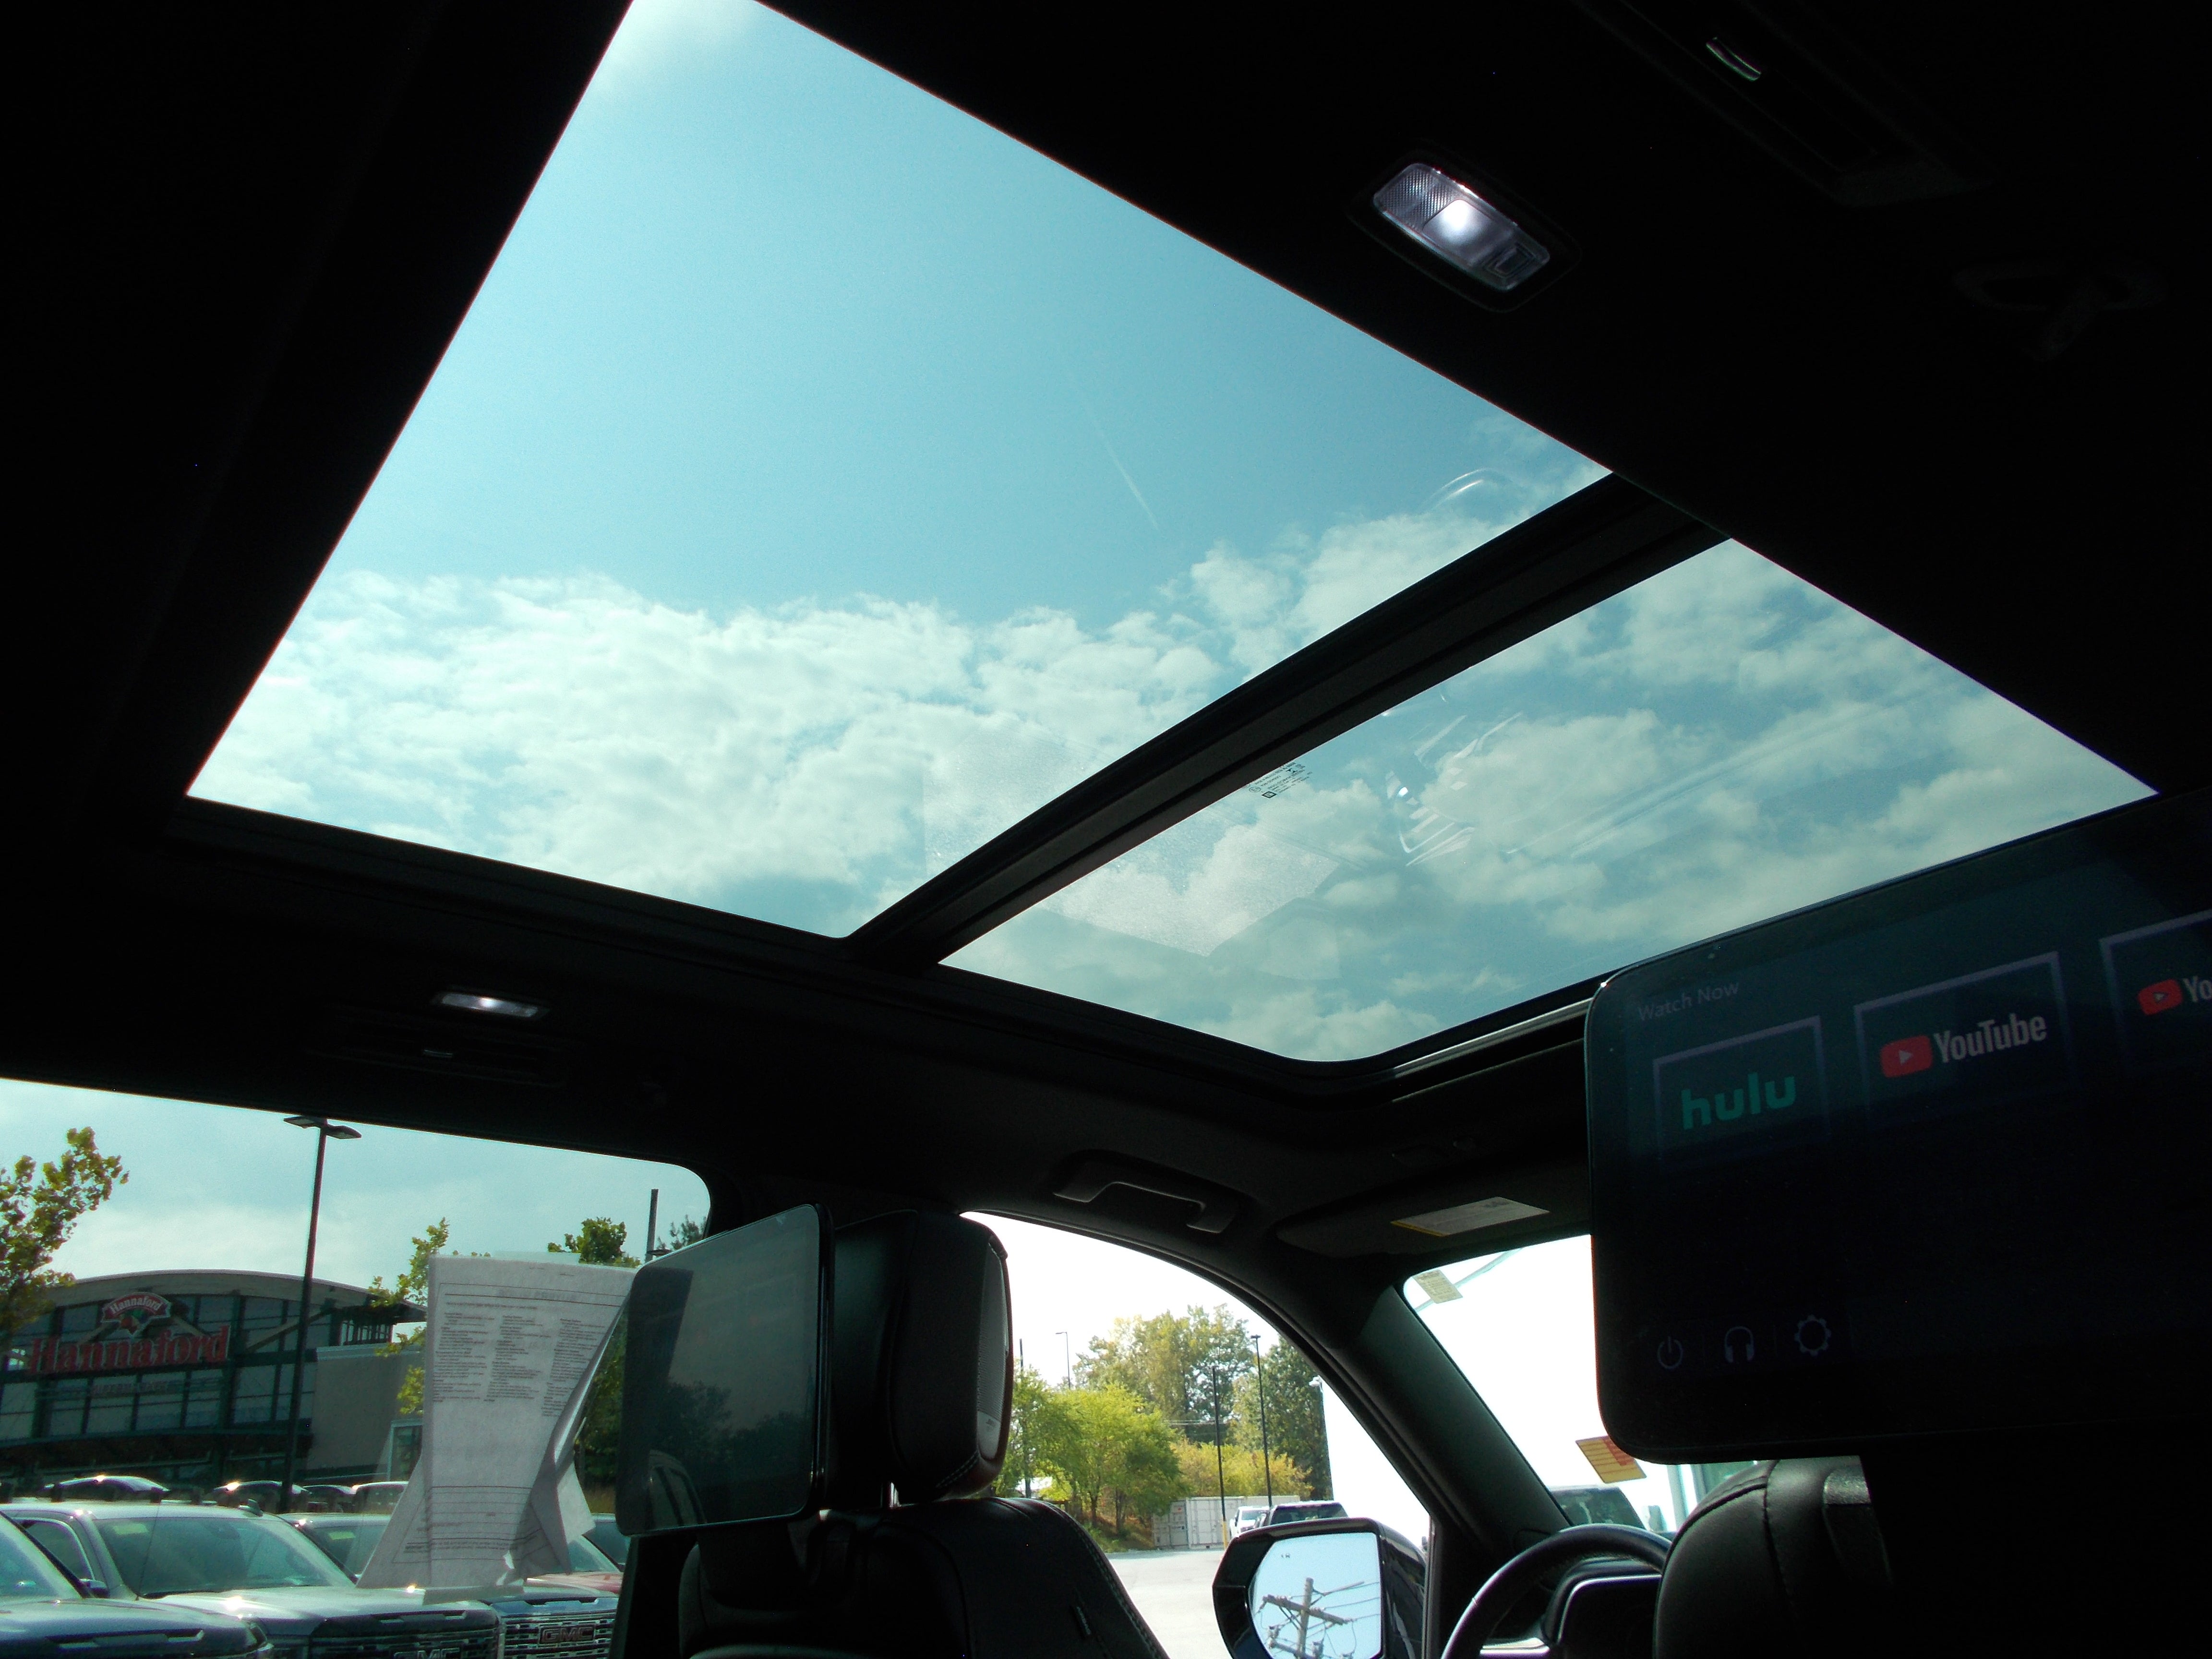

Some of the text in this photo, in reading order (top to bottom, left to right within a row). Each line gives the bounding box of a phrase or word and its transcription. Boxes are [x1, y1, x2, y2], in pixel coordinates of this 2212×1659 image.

[1637, 983, 1739, 1021] Watch Now
[1933, 1012, 2047, 1064] YouTube
[1681, 1071, 1796, 1130] hulu
[109, 1296, 163, 1314] Hannaford
[29, 1324, 230, 1375] Hannaford
[542, 1626, 594, 1644] GMC
